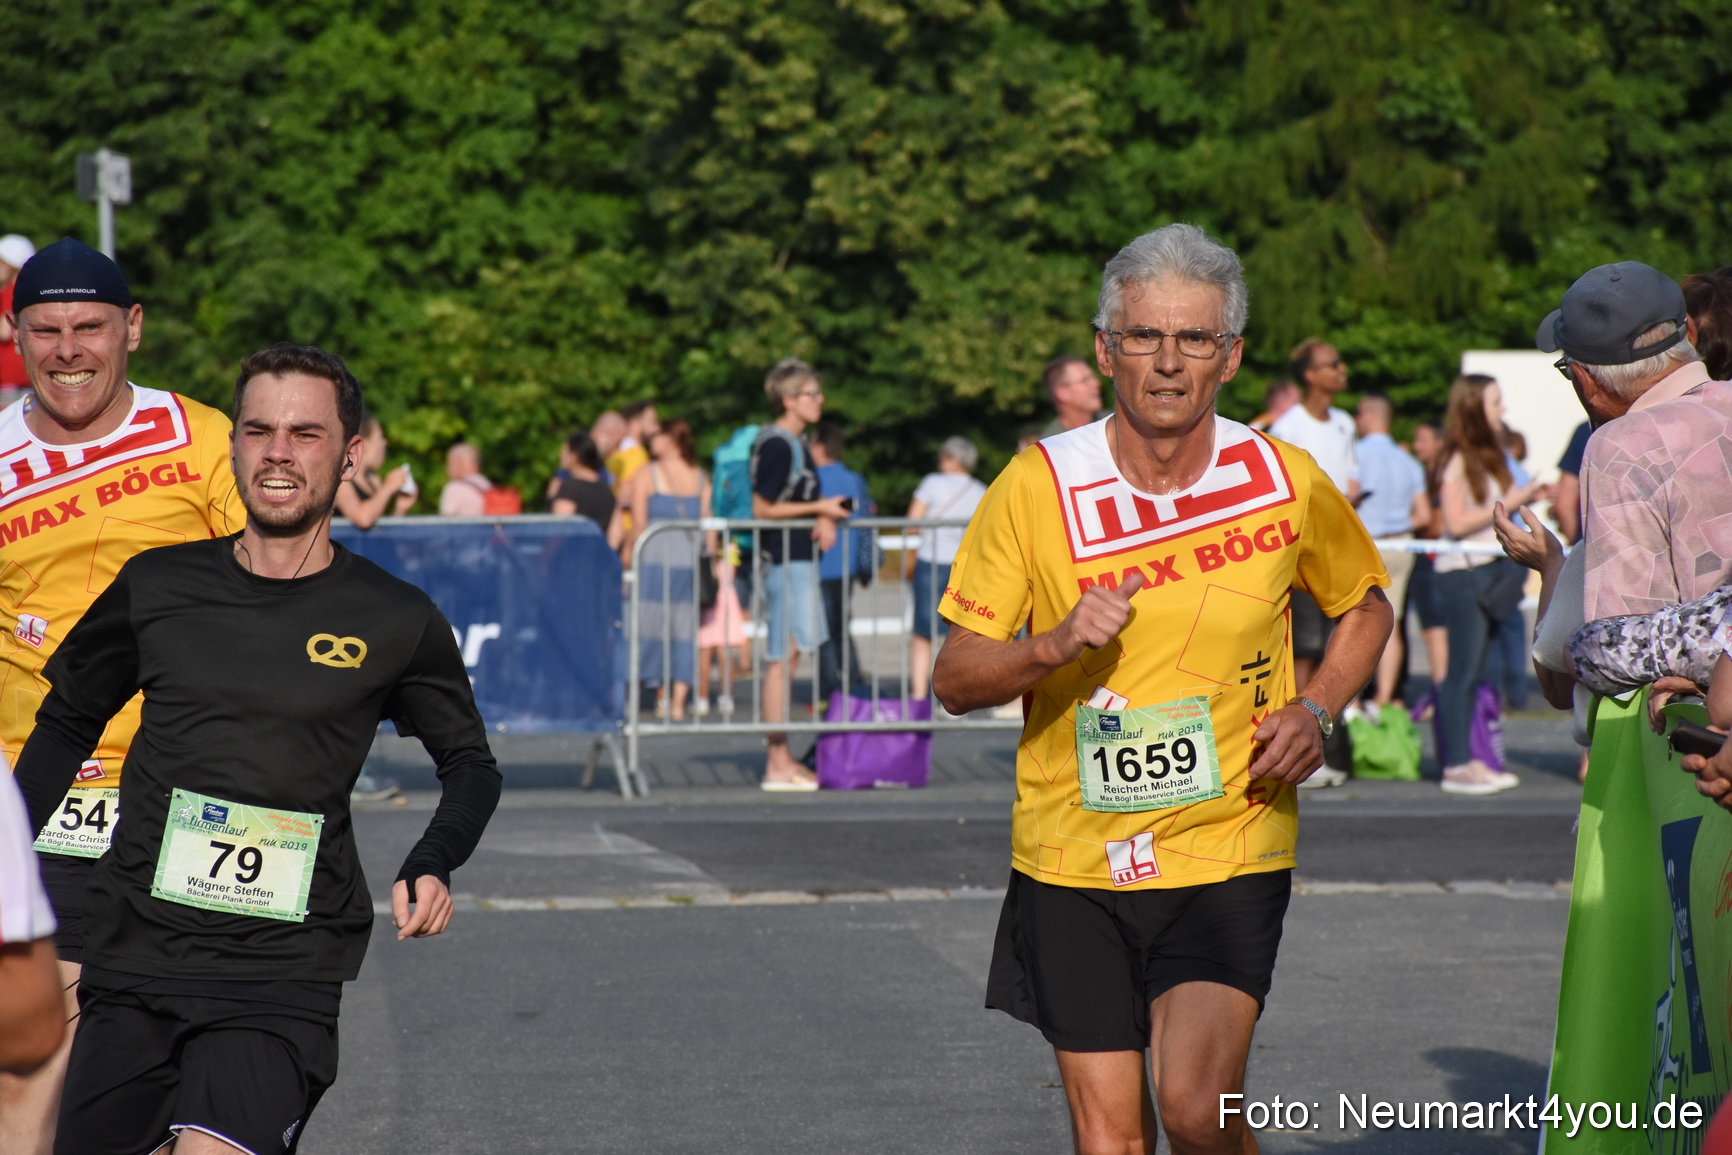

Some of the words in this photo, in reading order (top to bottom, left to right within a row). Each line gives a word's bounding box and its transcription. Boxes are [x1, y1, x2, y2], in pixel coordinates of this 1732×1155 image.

[0, 494, 86, 550] MAX
[96, 461, 202, 508] BÖGL
[1193, 520, 1301, 574] BÖGL
[1092, 727, 1144, 740] firmenlauf
[1178, 723, 1203, 736] 2019
[1093, 737, 1197, 783] 1659
[1103, 784, 1148, 794] Reichert
[1151, 776, 1193, 790] Michael
[1115, 795, 1132, 804] Bögl
[1134, 791, 1175, 801] Bauservice
[1176, 785, 1200, 796] GmbH
[39, 829, 75, 840] Bardos
[78, 834, 111, 844] Christ
[189, 814, 250, 837] firmenlauf
[280, 840, 308, 851] 2019
[47, 838, 64, 846] Bögl
[66, 841, 104, 850] Bauservice
[209, 840, 263, 884] 79
[186, 888, 220, 900] Bäckerei
[222, 894, 244, 904] Plank
[245, 898, 270, 907] GmbH
[187, 876, 231, 893] Wägner
[234, 885, 274, 899] Steffen
